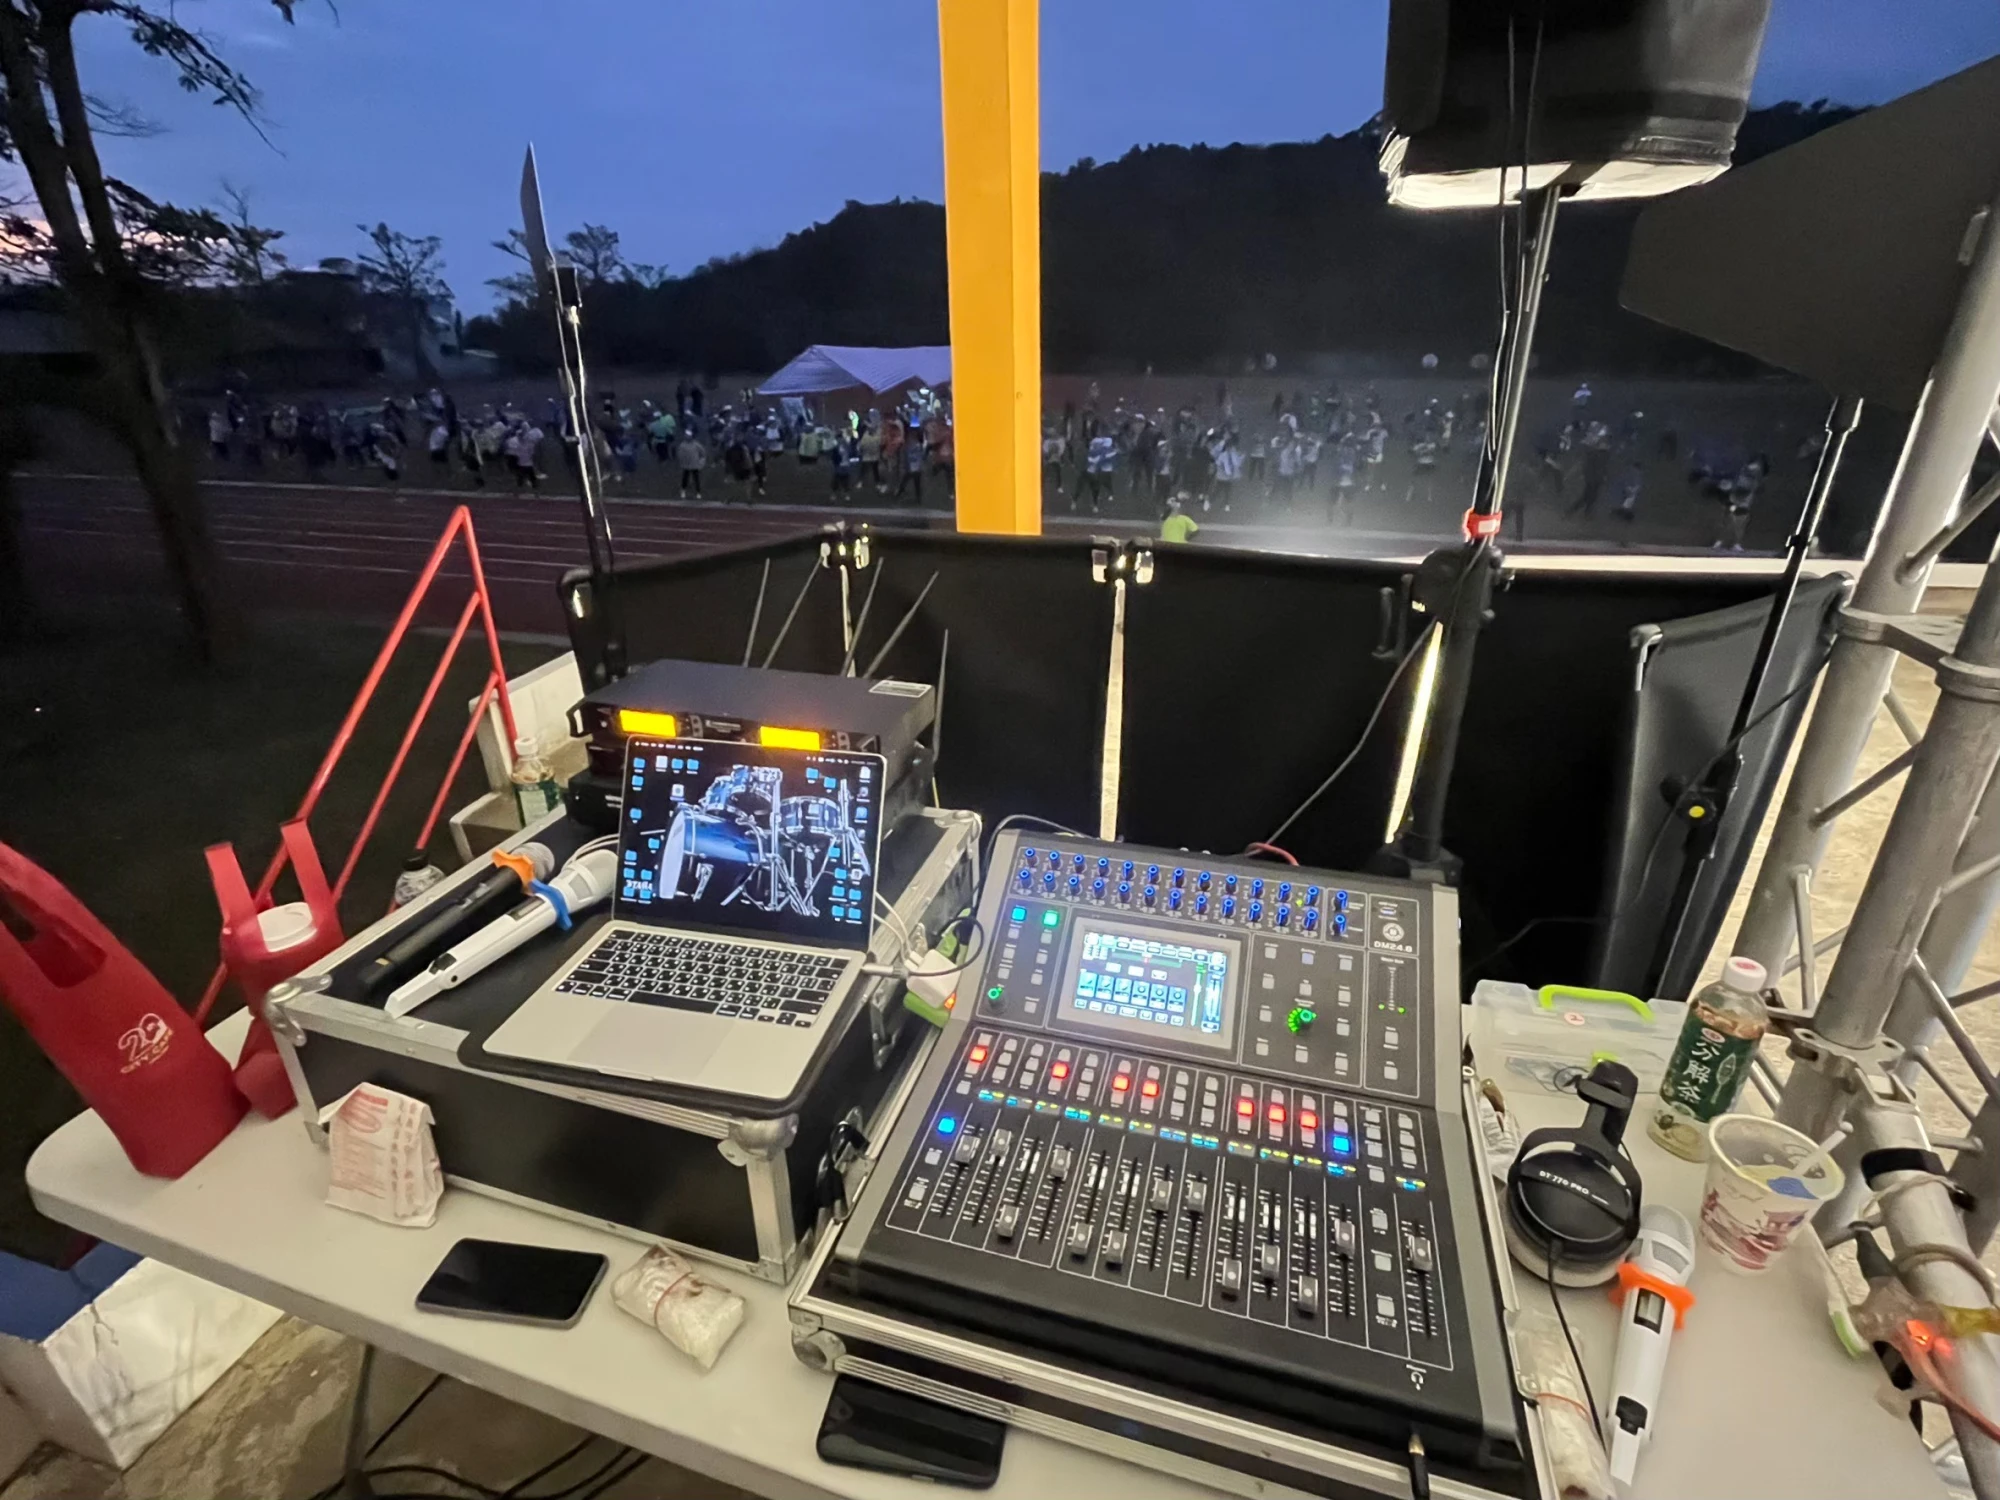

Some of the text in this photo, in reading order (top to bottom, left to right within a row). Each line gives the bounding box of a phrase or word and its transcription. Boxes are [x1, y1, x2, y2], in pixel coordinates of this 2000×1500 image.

[1677, 1041, 1720, 1104] 分解茶
[1539, 1170, 1590, 1195] DT 770 PRO
